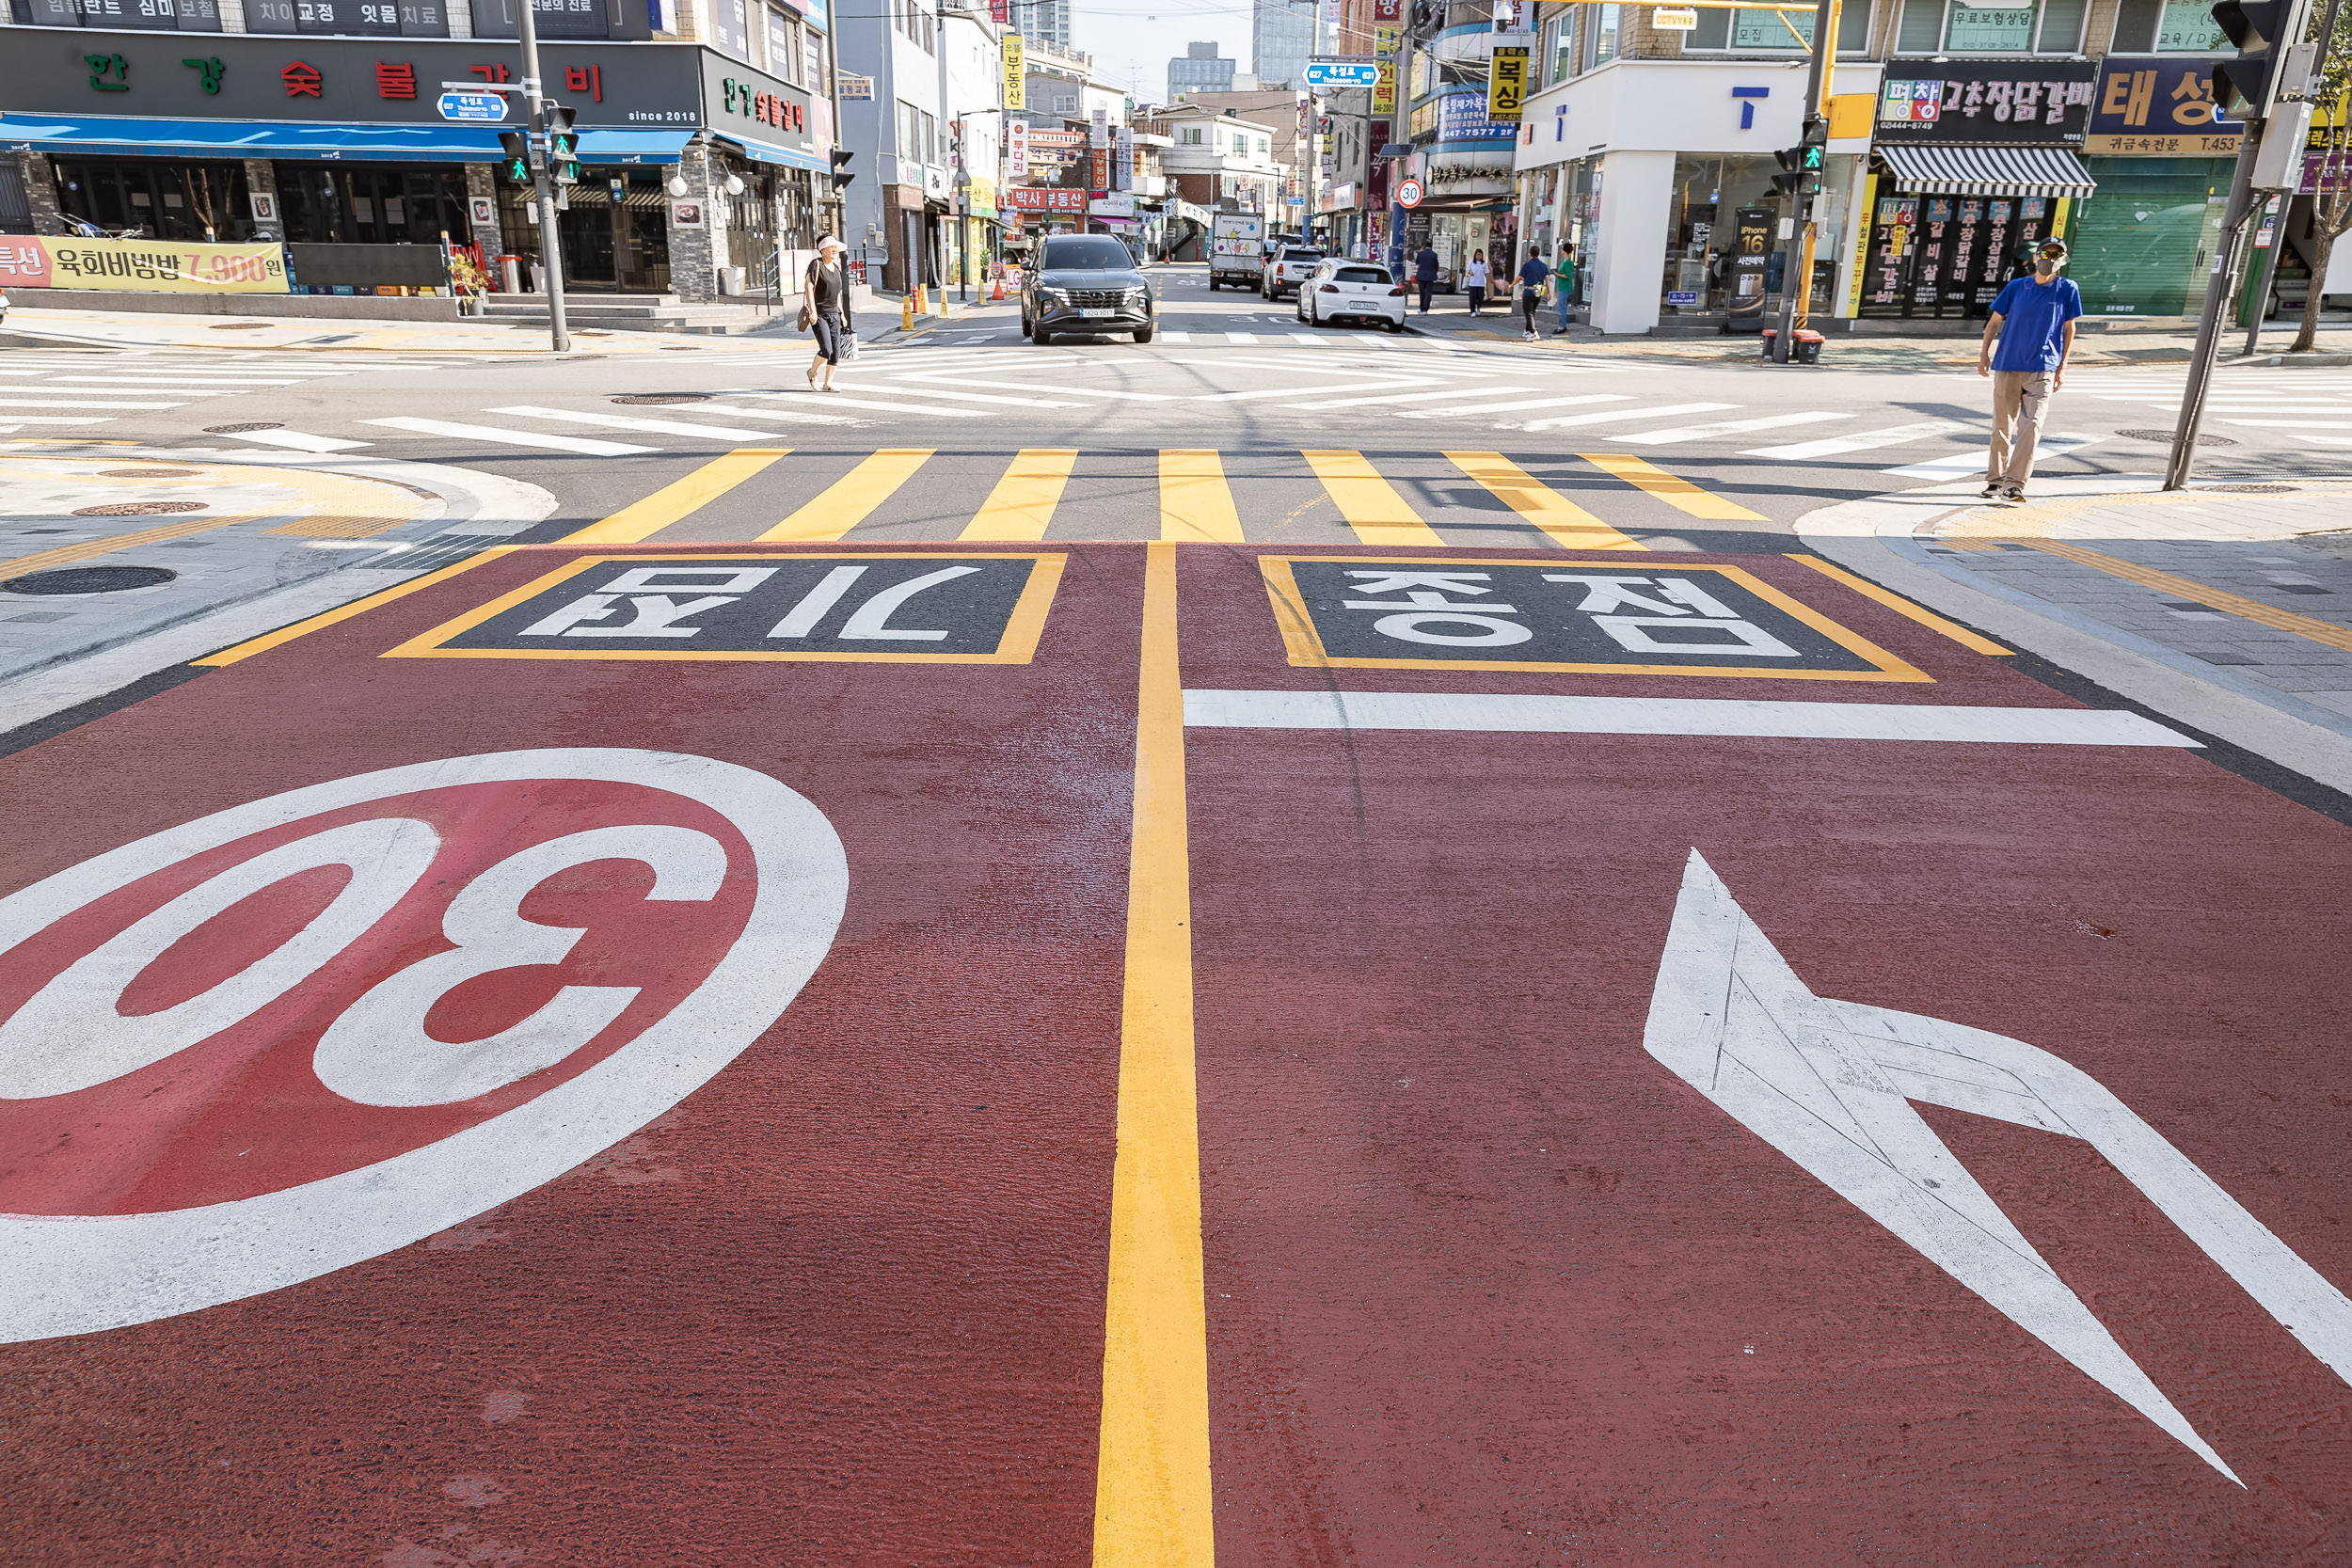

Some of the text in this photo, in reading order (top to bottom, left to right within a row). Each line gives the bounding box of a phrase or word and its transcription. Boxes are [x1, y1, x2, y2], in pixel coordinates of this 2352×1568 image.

[1739, 30, 1763, 42] 모집
[1007, 56, 1021, 105] 부동산
[1362, 71, 1375, 80] 631
[1496, 60, 1521, 109] 복싱
[1889, 83, 1940, 119] 평창
[628, 110, 696, 122] since 2018
[2109, 136, 2180, 151] 귀금속전문
[1015, 190, 1083, 208] 박사 부동산
[1403, 187, 1418, 200] 30
[1741, 234, 1765, 254] 16
[56, 248, 182, 280] 육회비빔밥
[1342, 569, 1804, 658] 종점
[0, 816, 729, 1108] 30
